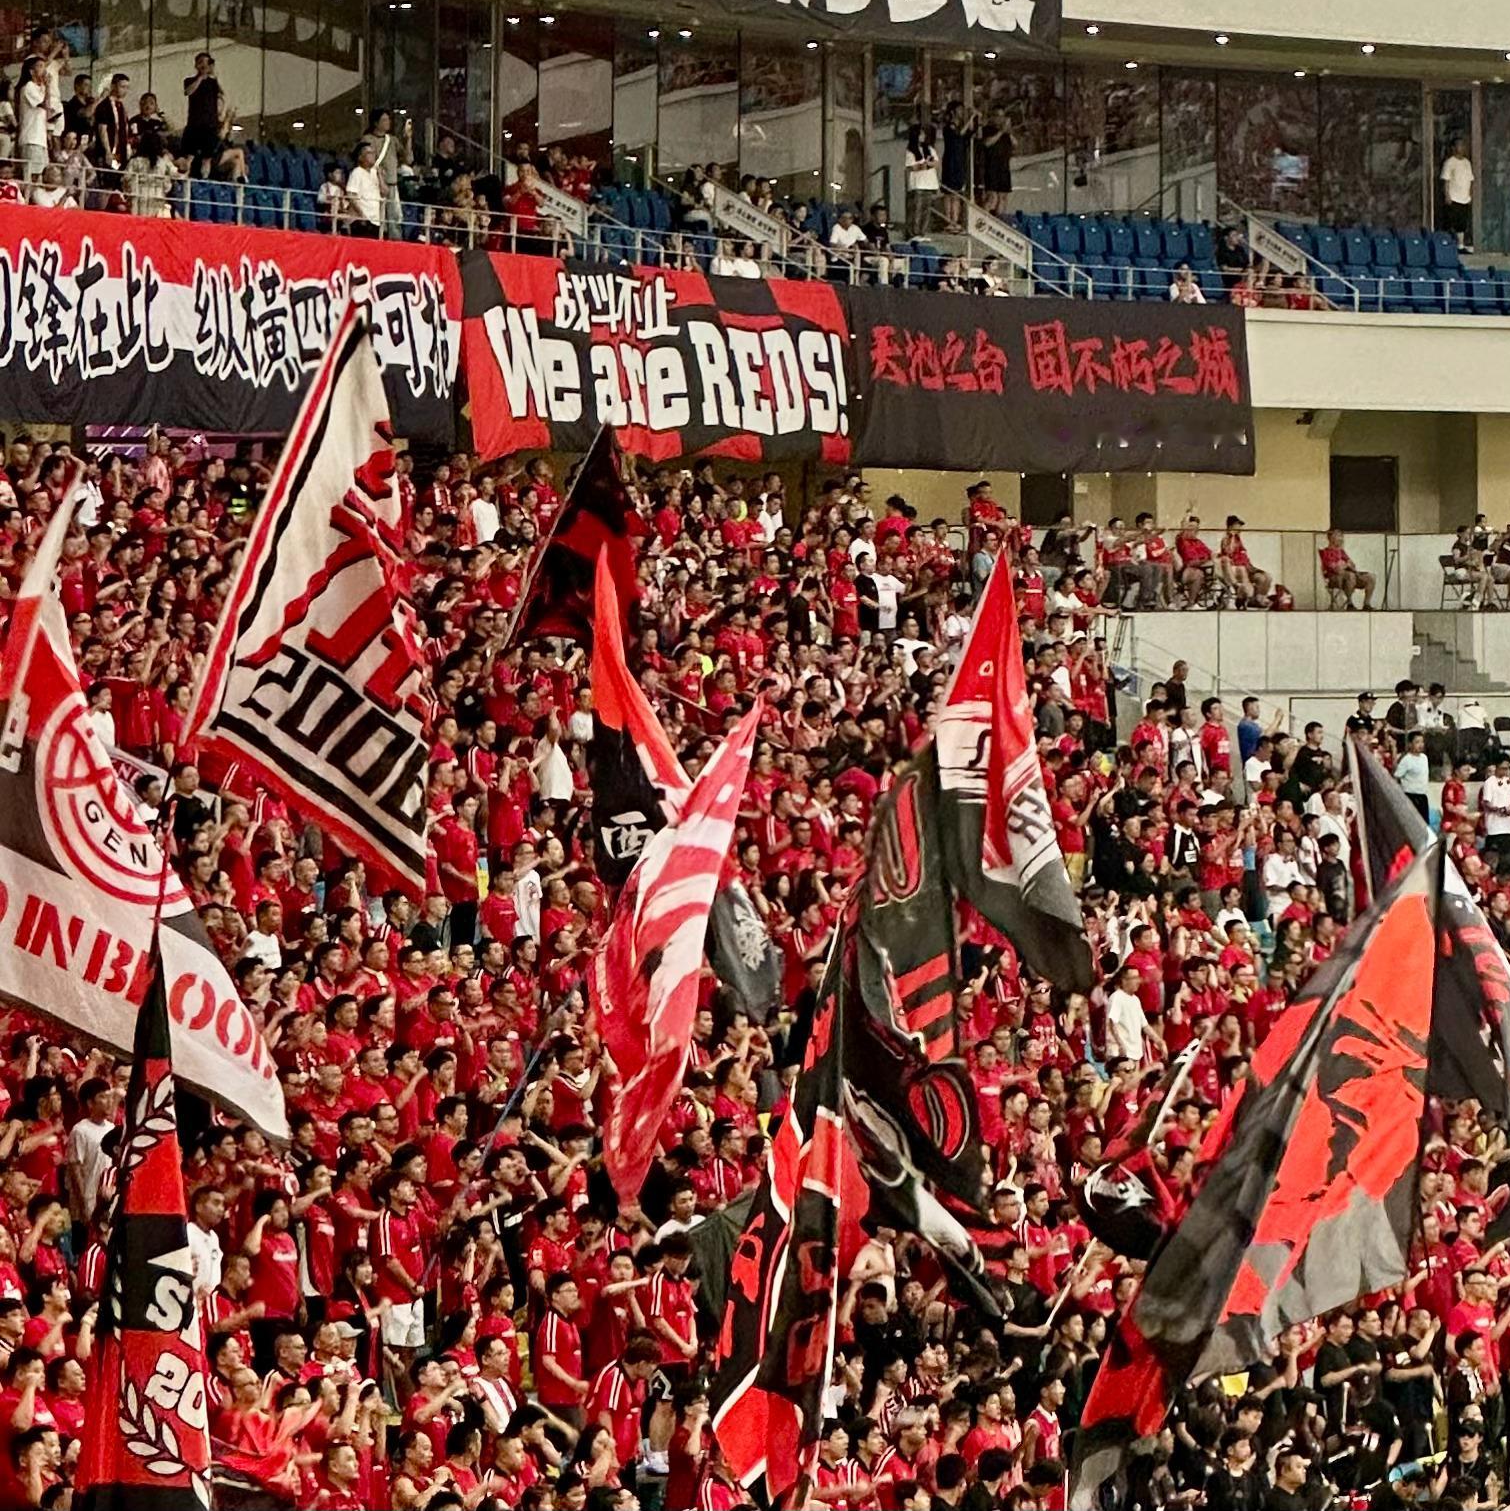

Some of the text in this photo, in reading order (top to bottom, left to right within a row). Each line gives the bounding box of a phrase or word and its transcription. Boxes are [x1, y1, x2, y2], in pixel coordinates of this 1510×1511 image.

[484, 306, 849, 437] We are REDS!
